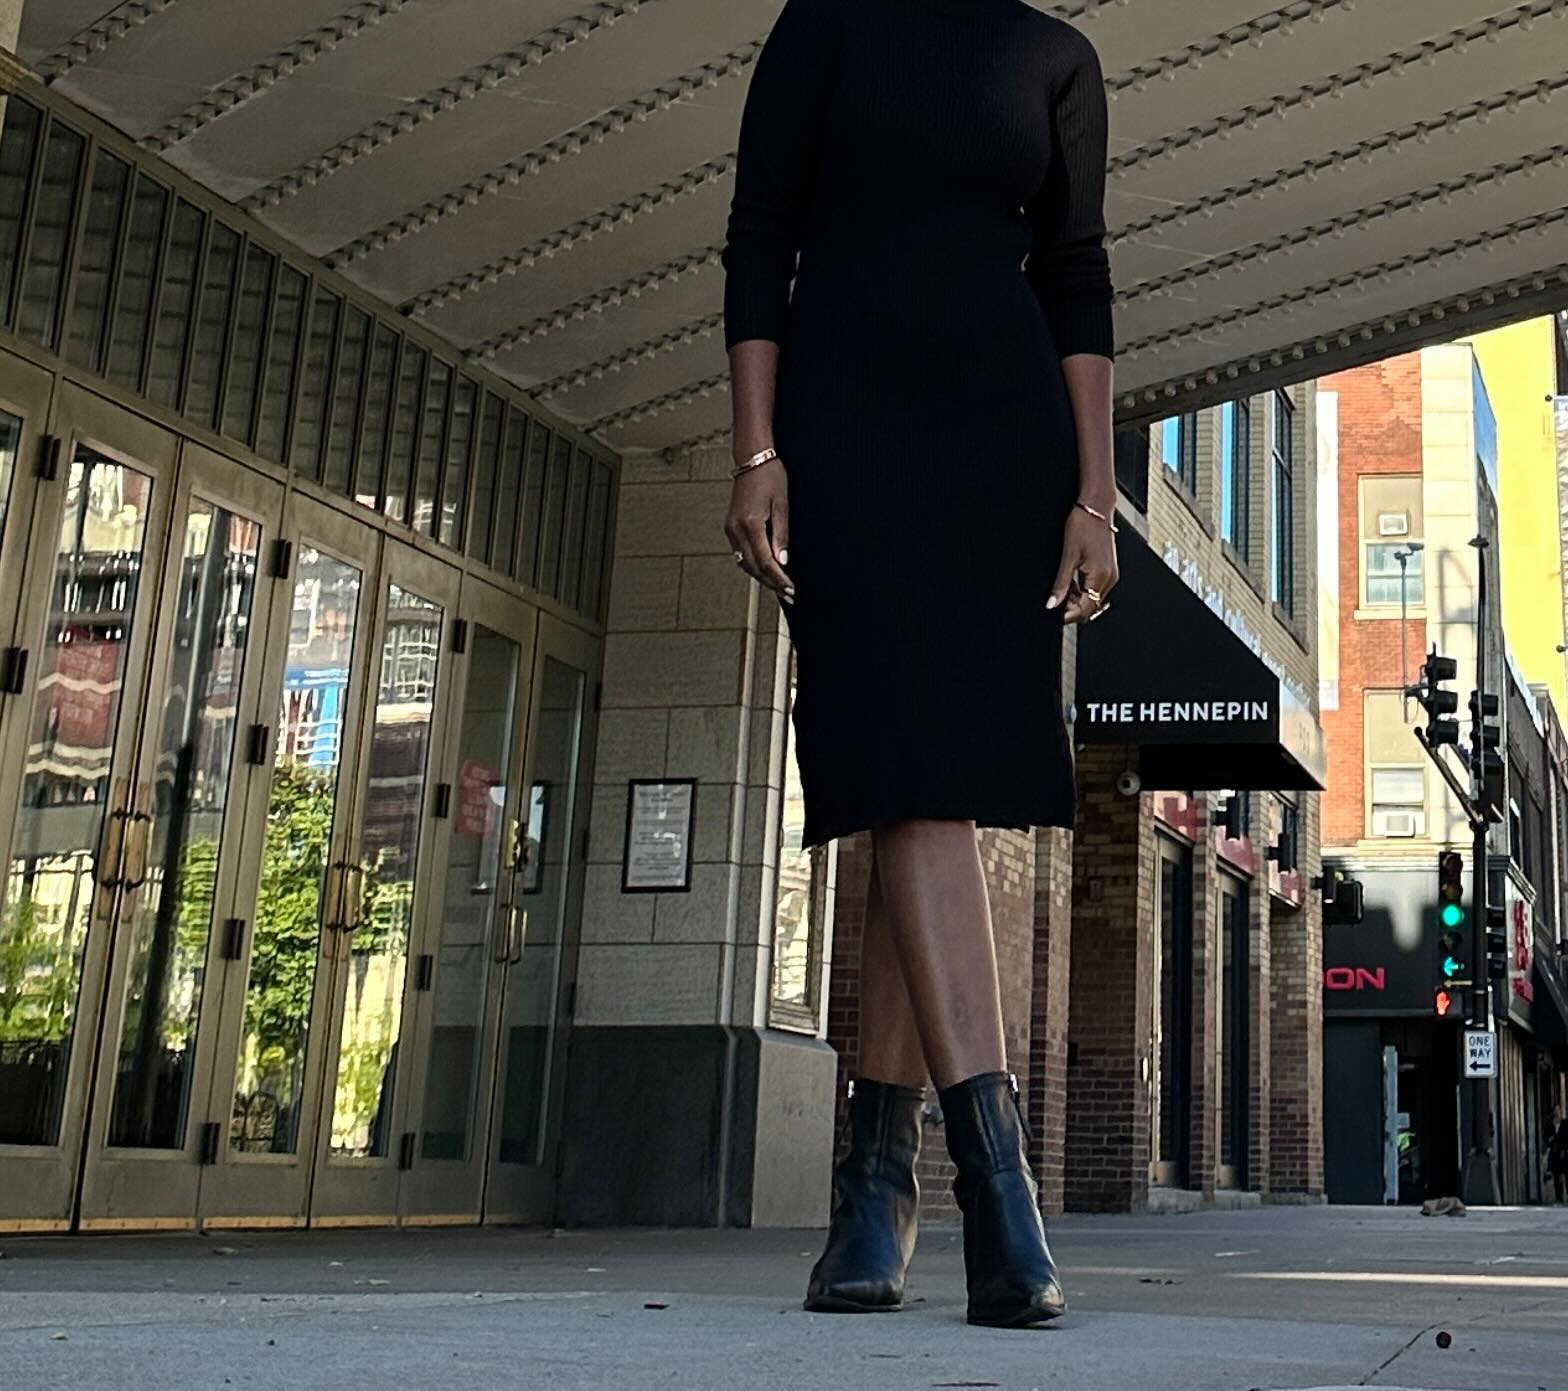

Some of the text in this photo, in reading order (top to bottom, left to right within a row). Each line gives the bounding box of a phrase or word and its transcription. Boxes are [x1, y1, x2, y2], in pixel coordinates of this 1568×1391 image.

[1086, 701, 1268, 722] THE HENNEPIN
[1319, 967, 1385, 990] ON
[1469, 1036, 1490, 1047] ONE
[1470, 1048, 1491, 1058] WAY
